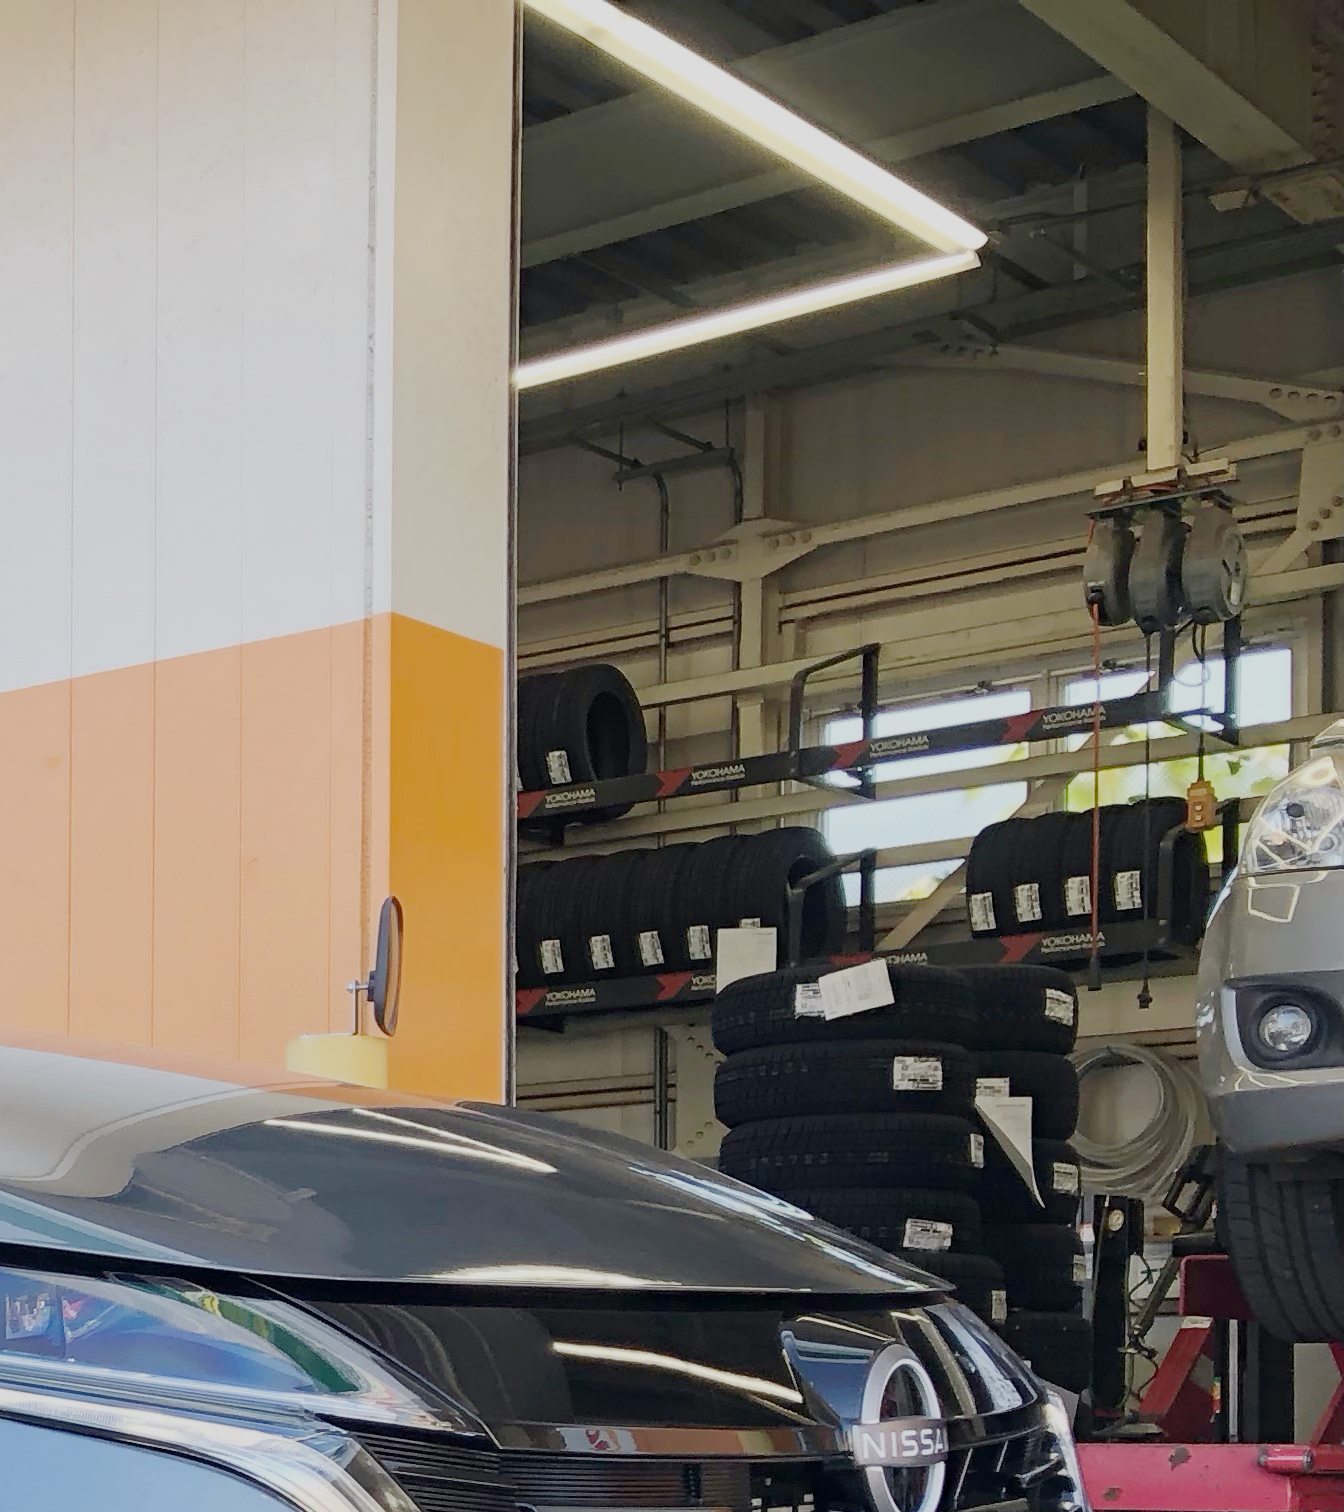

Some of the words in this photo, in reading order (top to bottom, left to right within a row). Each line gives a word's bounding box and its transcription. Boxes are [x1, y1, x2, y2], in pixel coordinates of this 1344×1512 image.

[870, 734, 930, 753] YOKOHAMA
[691, 764, 747, 780] YOKOHAMA
[544, 787, 596, 804] YOKOHAMA
[691, 974, 717, 987] YOKO
[544, 988, 597, 1003] YOKOHAMA
[862, 1427, 949, 1459] NISSA
